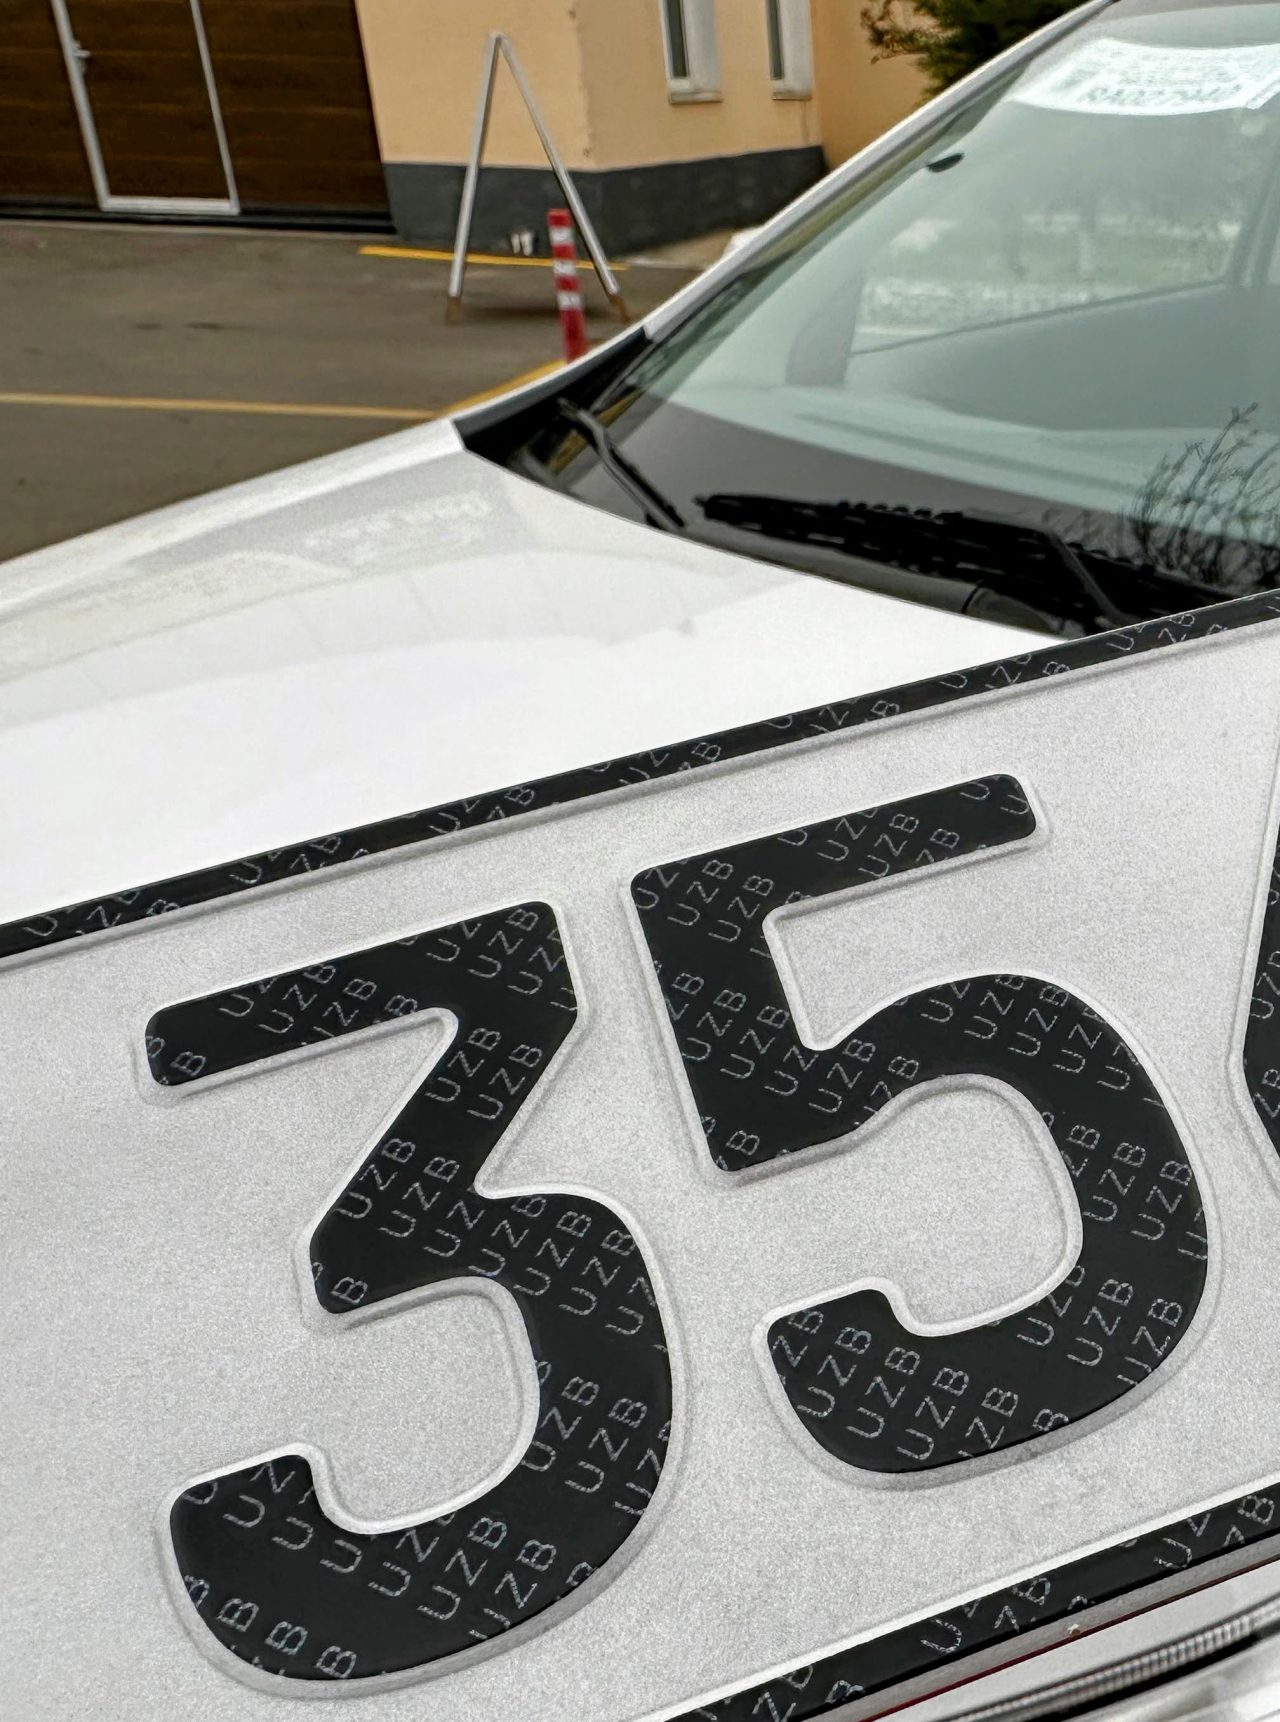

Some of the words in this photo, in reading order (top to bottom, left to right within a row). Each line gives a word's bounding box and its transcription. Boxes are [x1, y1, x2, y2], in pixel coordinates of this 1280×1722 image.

[816, 809, 878, 862] UZ
[857, 813, 920, 878] UZB
[636, 868, 680, 911] UZ
[666, 858, 734, 927] UZB
[707, 874, 775, 943] UZB
[467, 908, 540, 979] UZB
[507, 928, 564, 996] UZ
[665, 972, 705, 1021] ZB
[683, 988, 747, 1062] UZB
[1007, 984, 1072, 1057] UZB
[424, 1027, 502, 1103] UZB
[719, 1005, 790, 1080] UZB
[763, 1044, 820, 1097] UZ
[807, 1037, 877, 1114] UZB
[466, 1043, 544, 1121] UZB
[333, 1137, 417, 1220] UZB
[377, 1156, 461, 1238] UZB
[1082, 1141, 1148, 1223] UZB
[1130, 1160, 1193, 1241] UZB
[423, 1199, 486, 1258] UZ
[512, 1210, 592, 1297] UZB
[558, 1229, 635, 1316] UZB
[772, 1310, 825, 1368] ZB
[1065, 1278, 1134, 1367] UZB
[796, 1326, 872, 1418] UZB
[845, 1346, 921, 1439] UZB
[521, 1375, 600, 1473] UZB
[564, 1397, 648, 1494] UZB
[896, 1366, 970, 1461] UZB
[957, 1386, 1019, 1458] ZB
[222, 1463, 297, 1529] UZ
[367, 1513, 456, 1598] UZ
[416, 1516, 508, 1621] UZB
